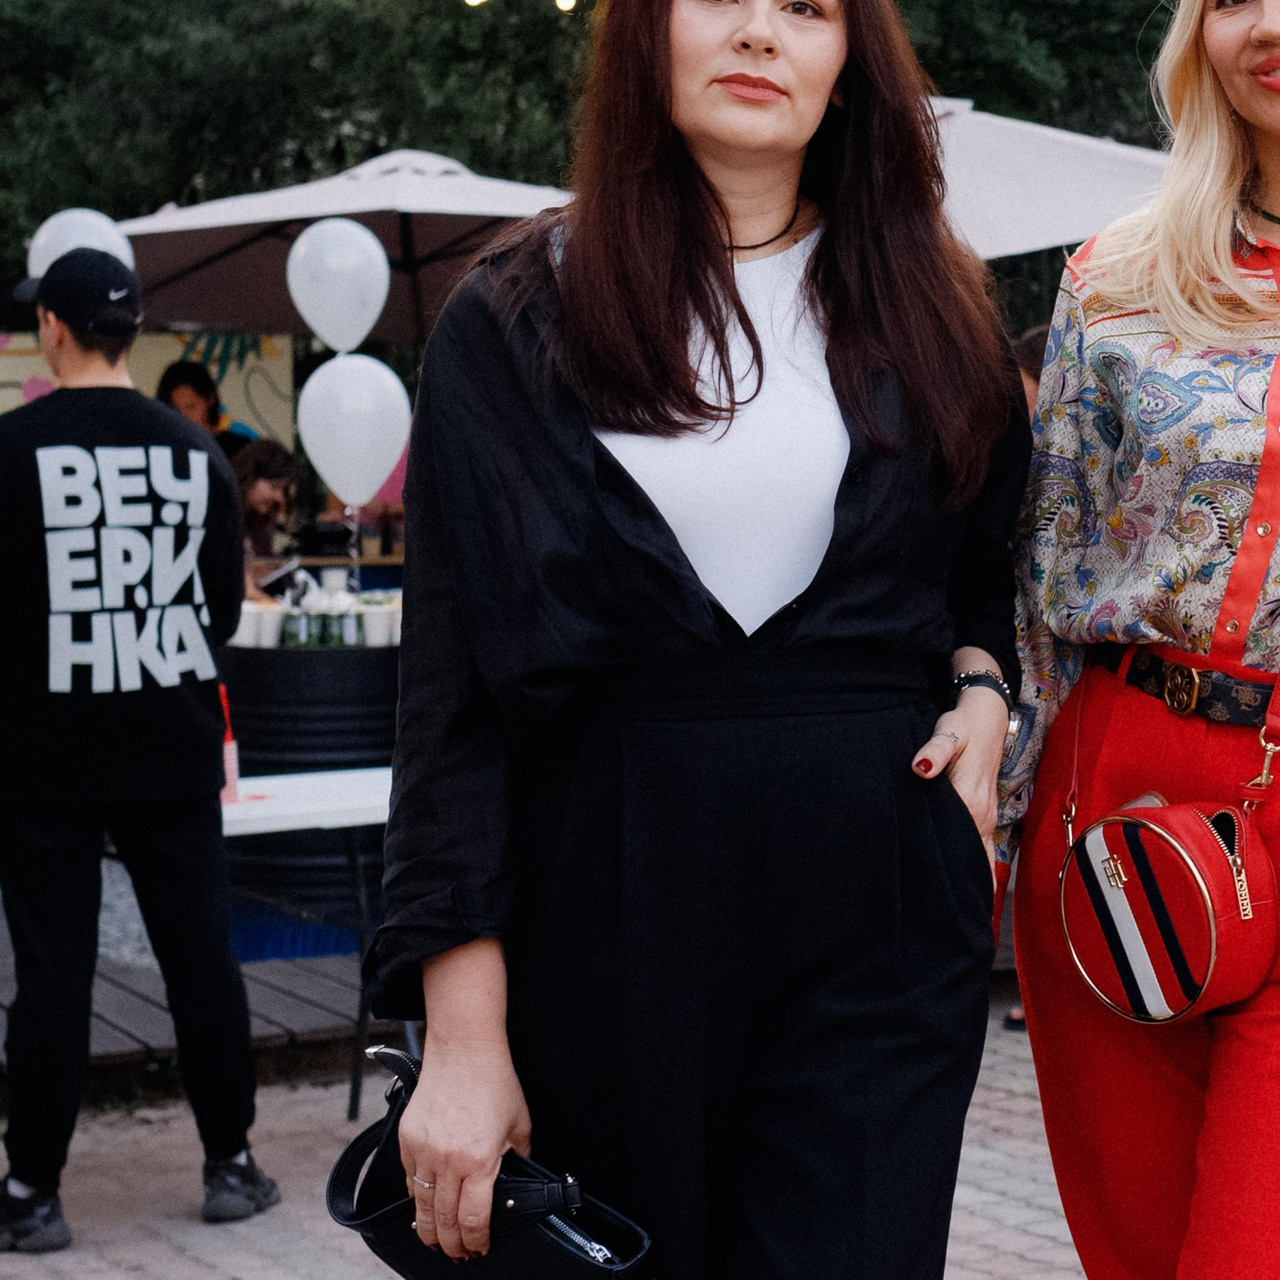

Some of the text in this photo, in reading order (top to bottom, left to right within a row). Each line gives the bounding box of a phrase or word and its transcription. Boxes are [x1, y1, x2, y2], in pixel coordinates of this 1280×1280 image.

[36, 445, 209, 528] ВЕЧ
[45, 526, 206, 612] ЕРИ
[49, 604, 217, 693] НКА
